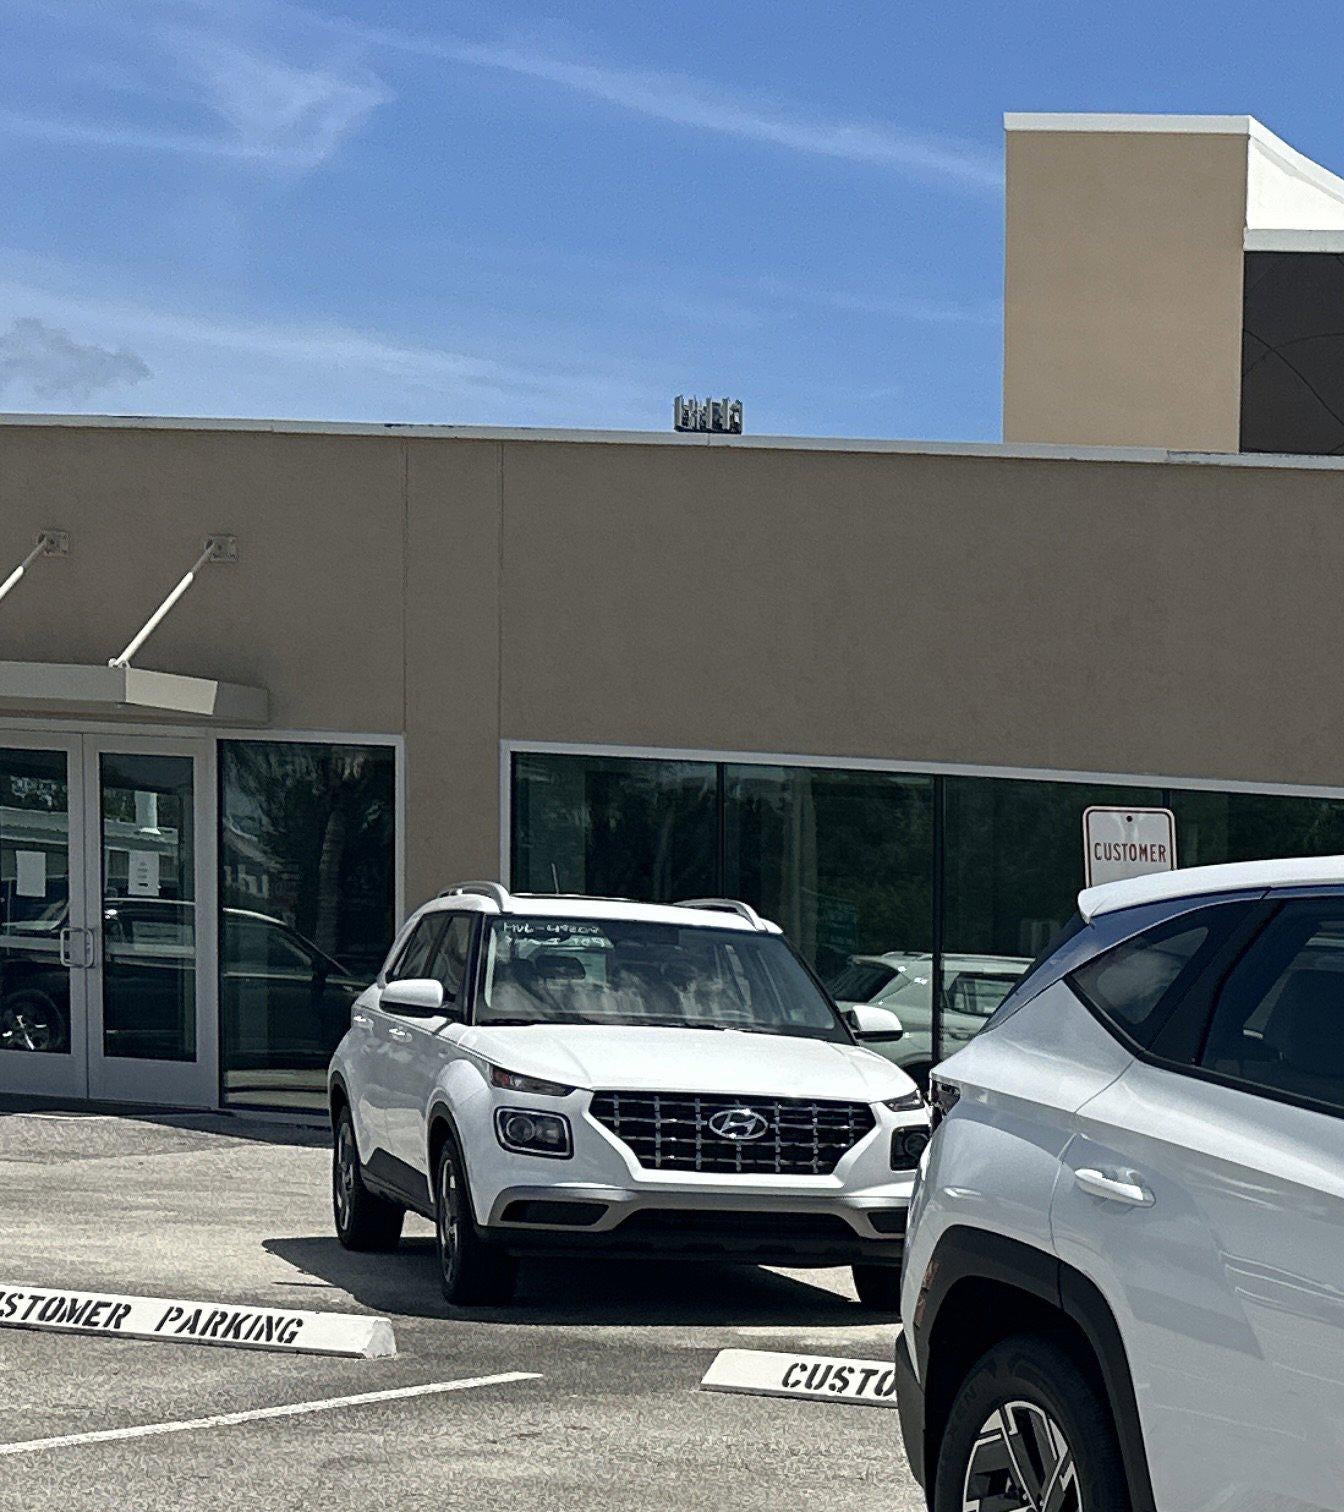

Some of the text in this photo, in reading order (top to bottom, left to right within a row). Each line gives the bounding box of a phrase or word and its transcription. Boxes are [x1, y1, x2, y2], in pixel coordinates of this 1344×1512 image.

[1094, 842, 1166, 862] CUSTOMER
[0, 1292, 304, 1344] STOMER PARKING
[781, 1363, 897, 1397] CUSTO
